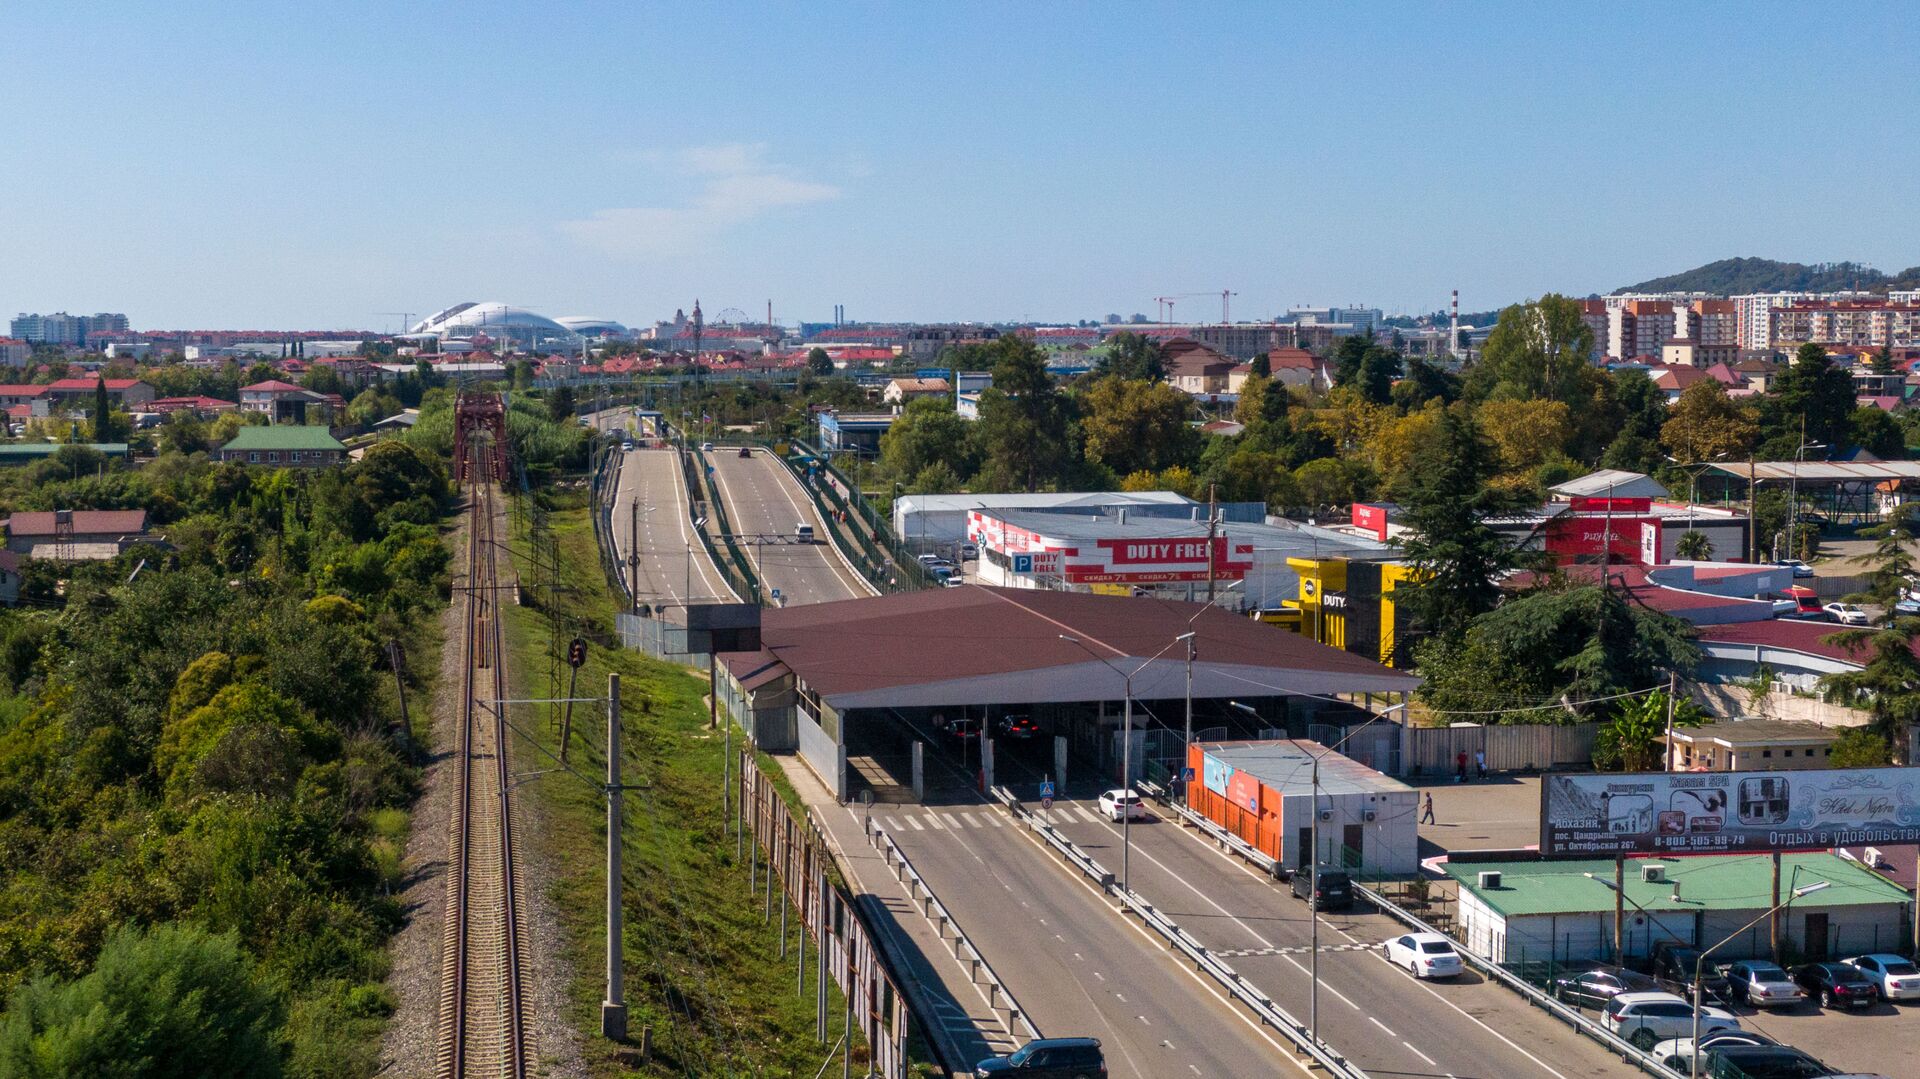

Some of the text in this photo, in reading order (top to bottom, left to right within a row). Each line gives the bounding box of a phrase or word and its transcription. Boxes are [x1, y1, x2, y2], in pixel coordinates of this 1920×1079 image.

[1127, 544, 1167, 559] DUTY
[1019, 557, 1029, 570] P
[1034, 554, 1058, 563] DUTY
[1034, 564, 1056, 573] FREE
[1709, 775, 1730, 787] SPA
[1769, 832, 1814, 846] Отдых
[1820, 832, 1828, 843] в
[1554, 843, 1566, 851] ул.
[1568, 841, 1619, 851] Октябрьская
